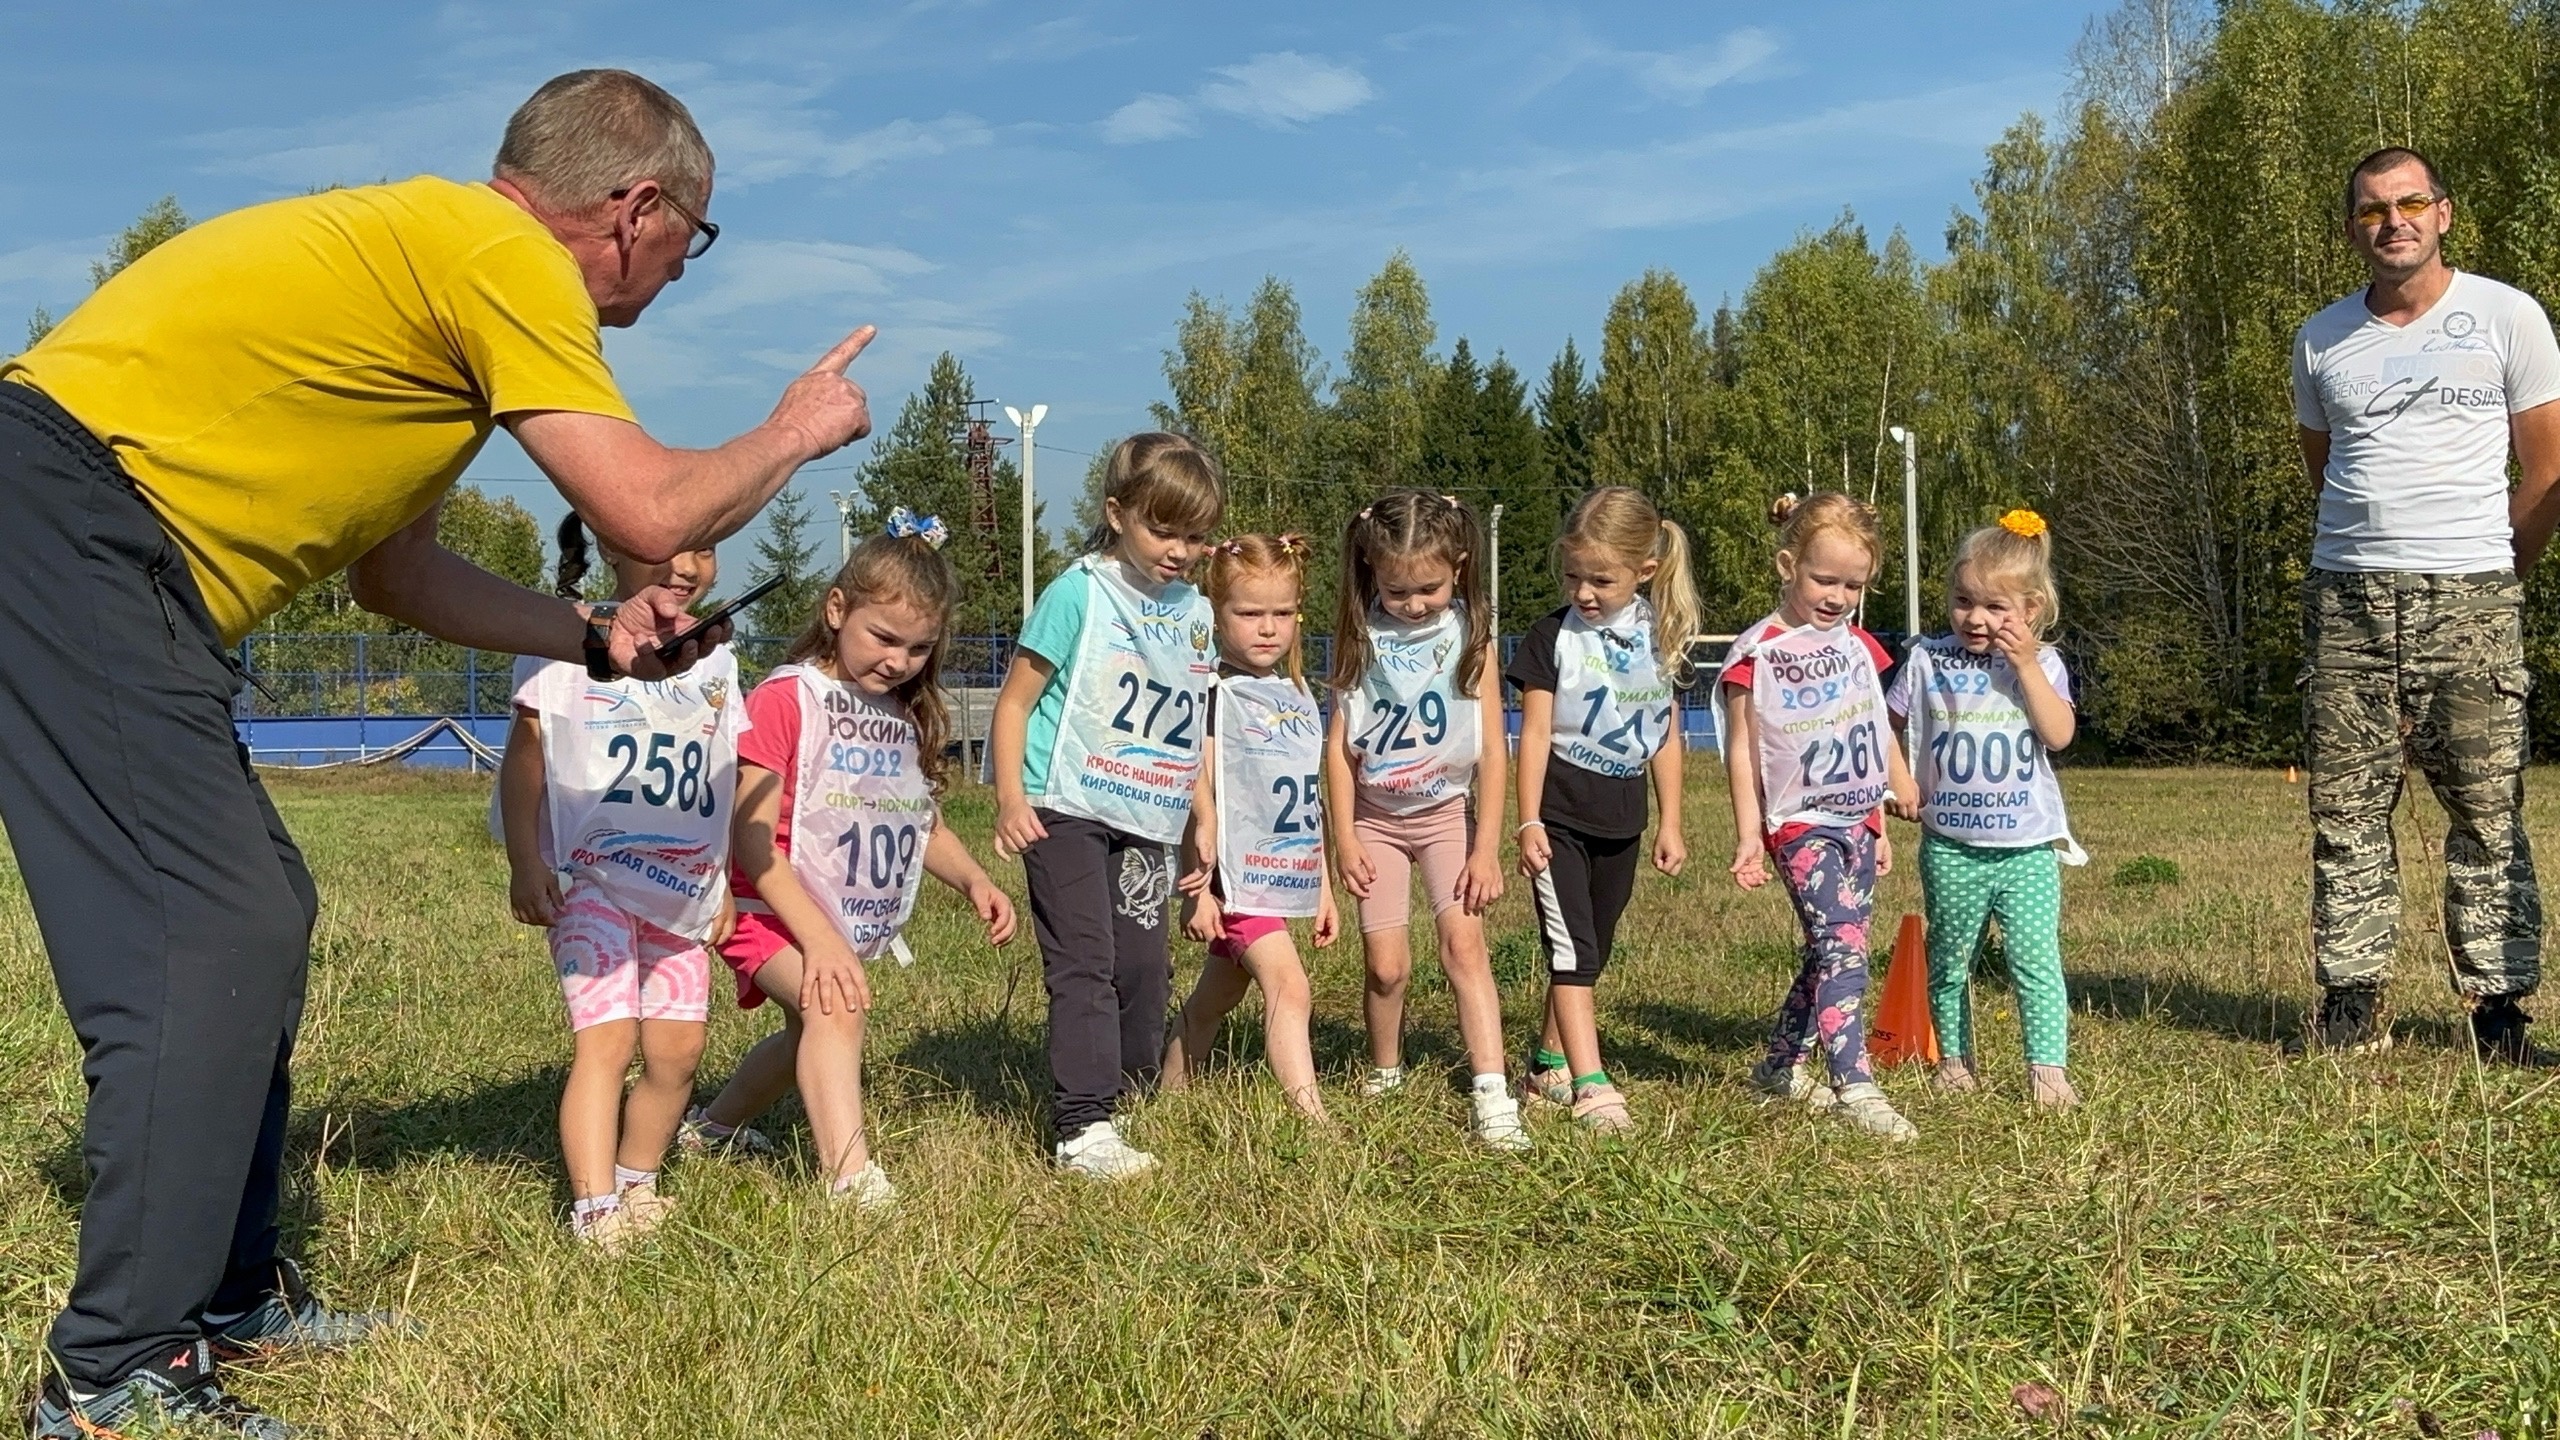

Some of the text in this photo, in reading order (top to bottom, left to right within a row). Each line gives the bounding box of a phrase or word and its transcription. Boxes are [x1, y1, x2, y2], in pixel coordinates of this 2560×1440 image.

[1772, 654, 1850, 684] РОССИИ
[828, 714, 907, 745] РОССИИ
[829, 742, 902, 778] 2022
[1568, 741, 1645, 779] КИРОВС
[1800, 720, 1885, 787] 1261
[1931, 728, 2036, 785] 1009
[1086, 755, 1129, 778] КРОСС
[1132, 768, 1174, 788] НАЦИИ
[825, 792, 865, 811] СПОРТ
[1080, 774, 1192, 811] КИРОВСКАЯ ОБЛАС
[1936, 812, 2018, 830] ОБЛАСТЬ
[1245, 854, 1288, 869] КРОСС
[646, 864, 707, 901] ОБЛАСТ
[1243, 871, 1310, 890] КИРОВСКАЯ
